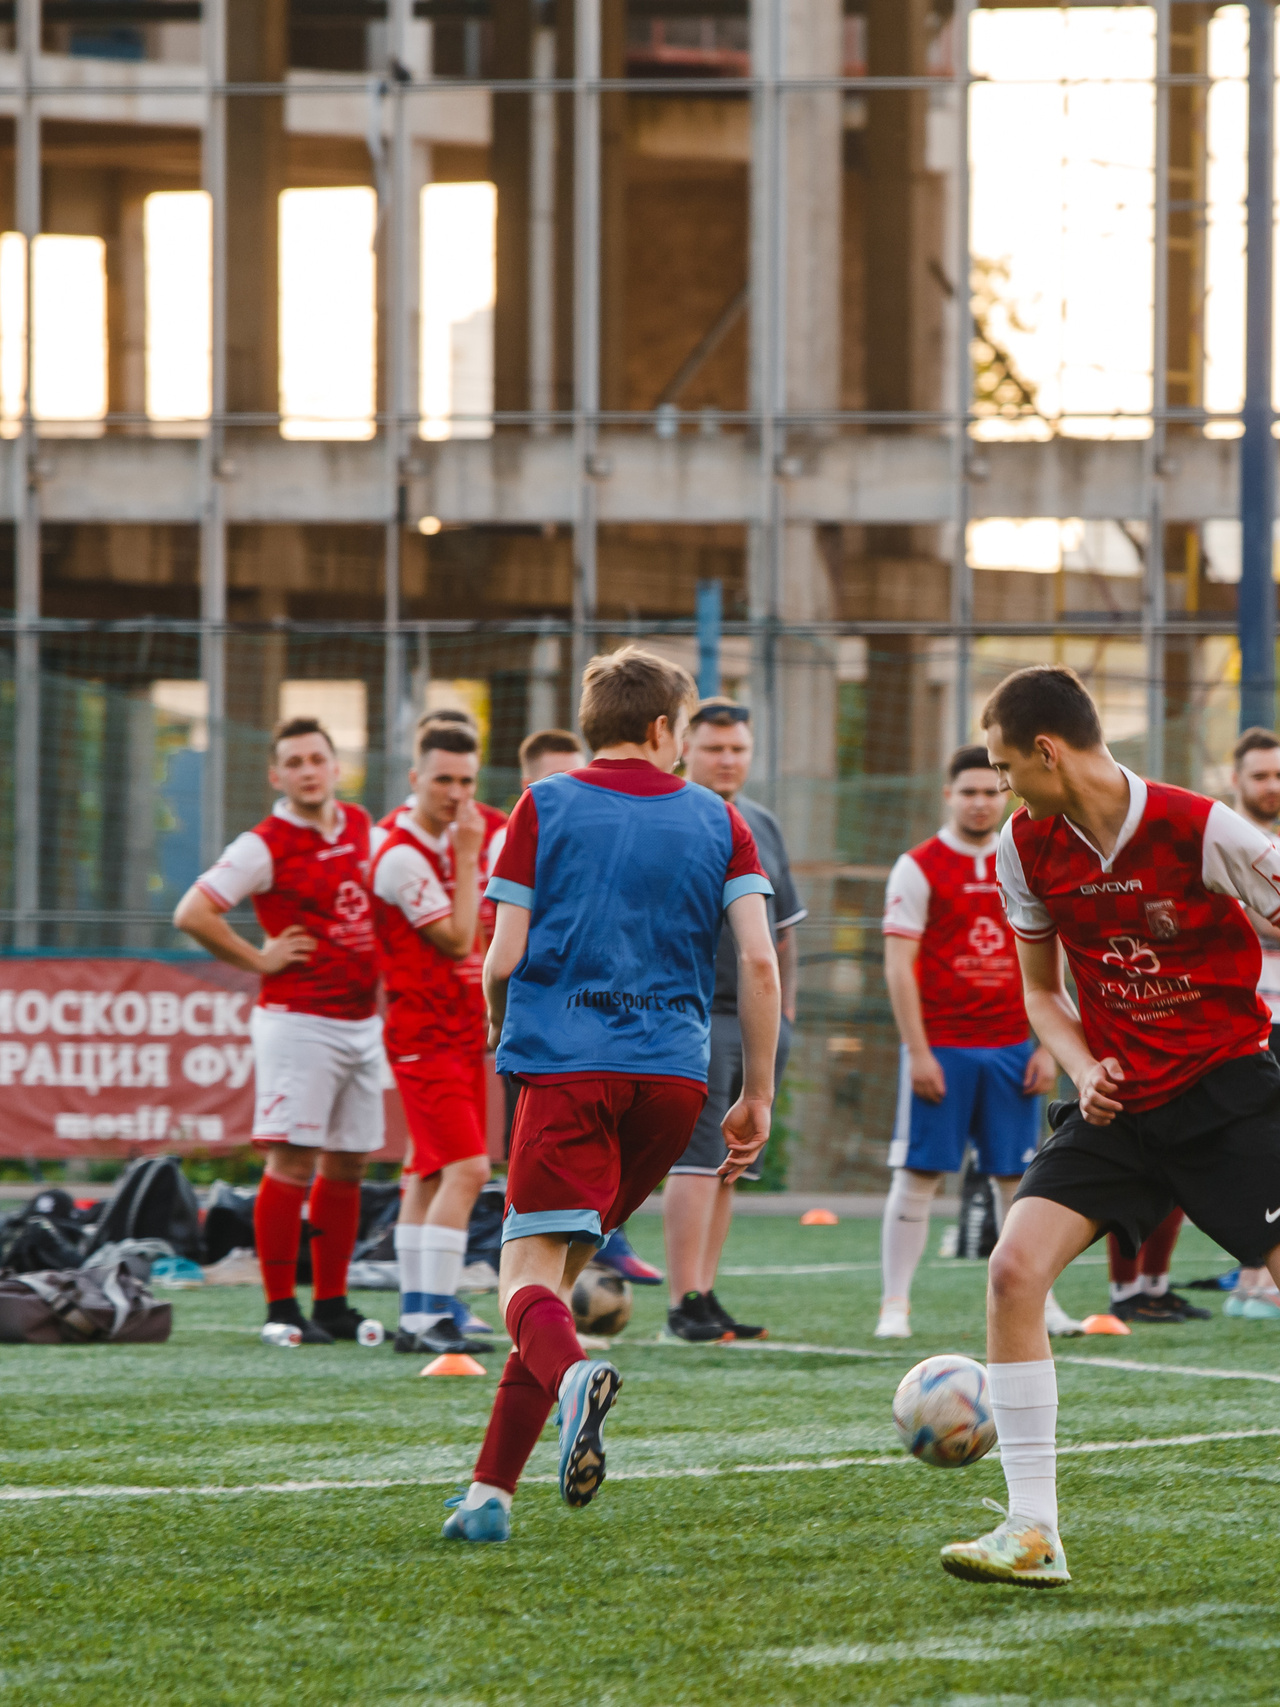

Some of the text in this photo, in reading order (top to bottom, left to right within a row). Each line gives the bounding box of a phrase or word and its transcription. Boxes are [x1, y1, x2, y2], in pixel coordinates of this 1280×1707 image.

[1080, 879, 1143, 895] GIVOVA
[0, 988, 251, 1036] ОСКОВСК
[566, 988, 686, 1014] ritmsportru
